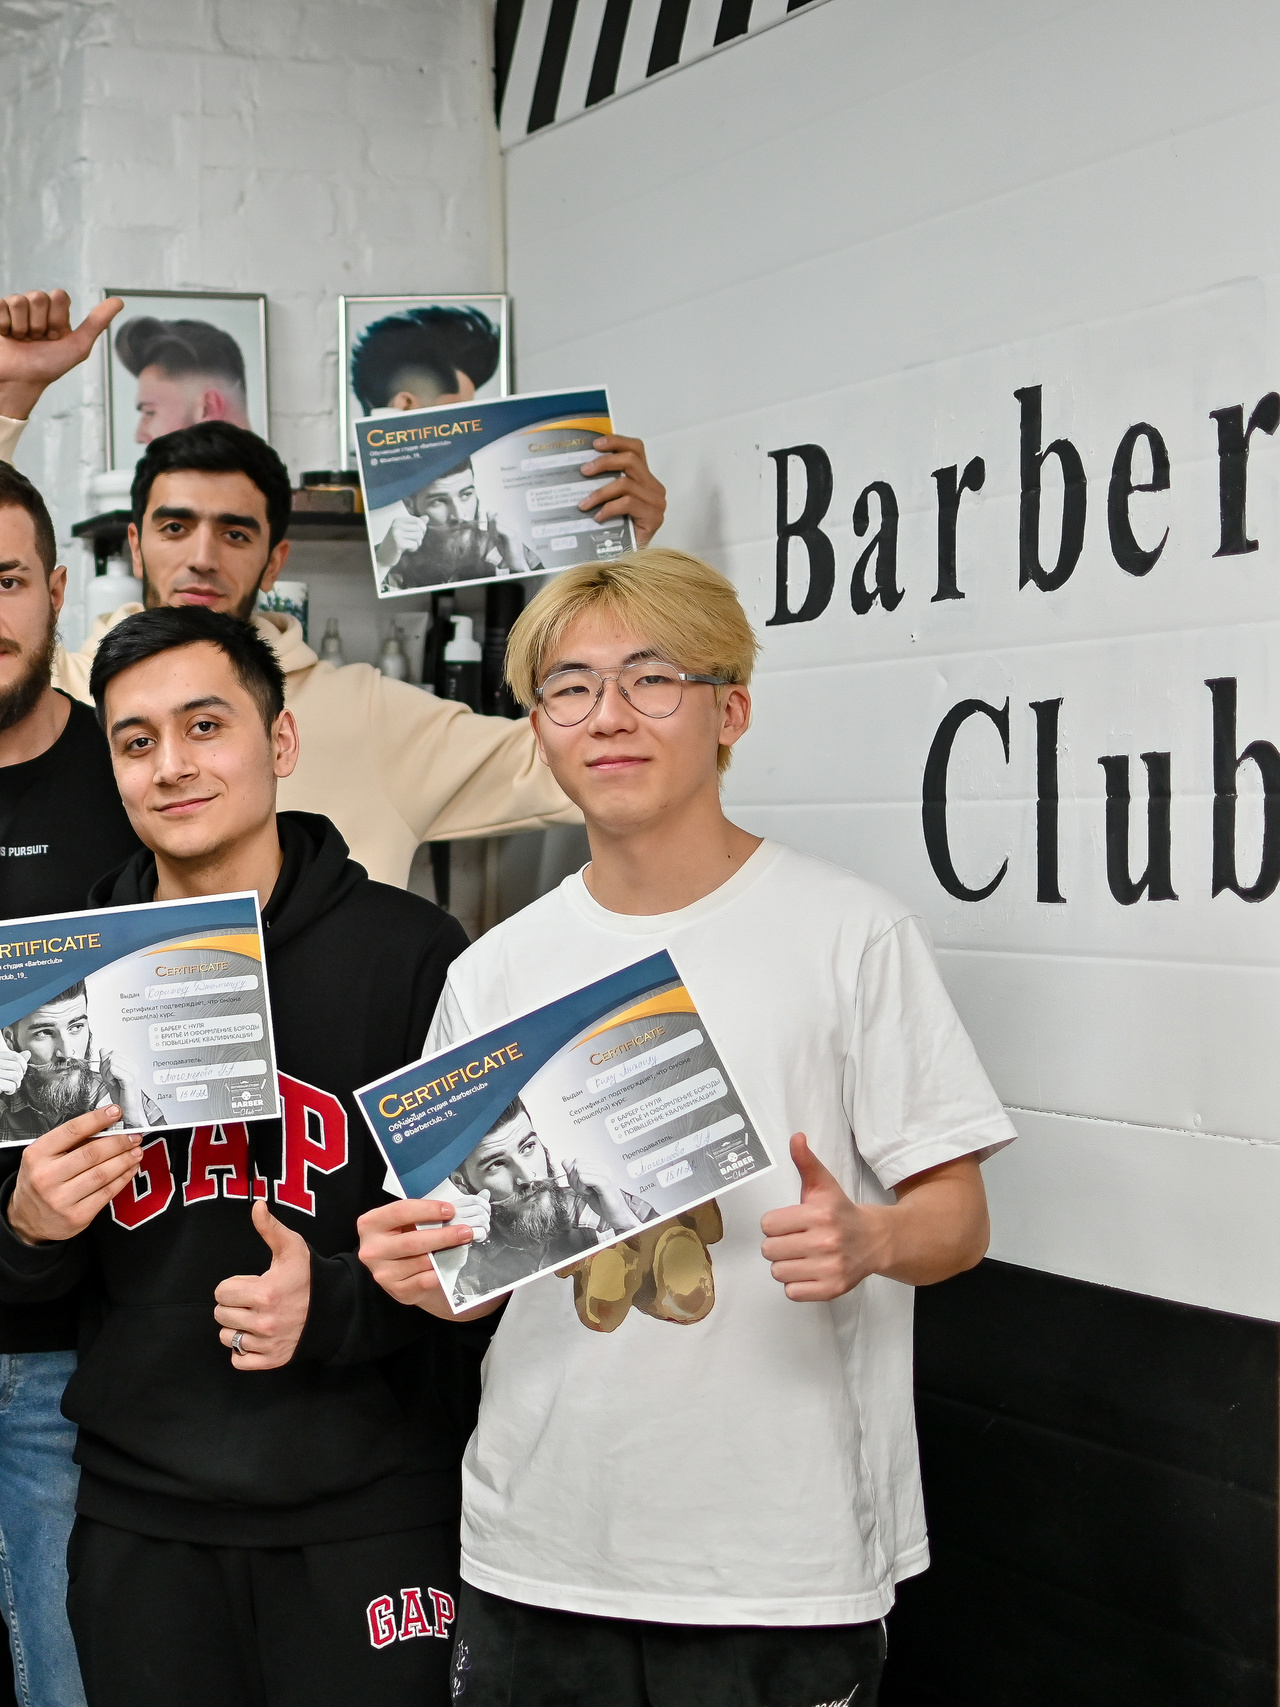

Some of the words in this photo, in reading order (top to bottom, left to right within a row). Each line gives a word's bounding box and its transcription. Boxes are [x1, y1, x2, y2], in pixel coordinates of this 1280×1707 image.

[367, 419, 482, 446] CERTIFICATE
[766, 384, 1280, 626] Barber
[922, 676, 1280, 904] Club
[8, 844, 49, 857] PURSUIT
[2, 962, 23, 970] студия
[24, 957, 62, 966] «Barberclub»
[155, 961, 228, 976] CERTIFICATE
[121, 1004, 158, 1014] Сертификат
[159, 999, 206, 1010] подтверждает,
[121, 1012, 159, 1022] прошел(ла)
[160, 1024, 182, 1032] БАРБЕР
[161, 1037, 200, 1046] ПОВЫШЕНИЕ
[202, 1032, 253, 1042] КВАЛИФИКАЦИИ
[189, 1026, 232, 1036] ОФОРМЛЕНИЕ
[233, 1024, 259, 1032] БОРОДЫ
[589, 1024, 666, 1065] CERTIFICATE
[379, 1041, 524, 1117] CERTIFICATE
[568, 1095, 608, 1117] Сертификат
[606, 1072, 656, 1100] подтверждает,
[654, 1067, 668, 1076] что
[667, 1056, 691, 1071] он/она
[230, 1099, 264, 1108] BARBER
[425, 1100, 448, 1114] студия
[447, 1080, 488, 1103] «Barberclub»
[561, 1088, 583, 1103] Выдан
[648, 1091, 694, 1115] ОФОРМЛЕНИЕ
[693, 1078, 721, 1095] БОРОДЫ
[572, 1102, 611, 1125] прошел(ла)
[616, 1107, 640, 1122] БАРБЕР
[645, 1096, 663, 1108] НУЛЯ
[623, 1113, 664, 1136] ПОВЫШЕНИЕ
[664, 1089, 717, 1117] КВАЛИФИКАЦИИ
[403, 1108, 457, 1137] @barberclub_19_
[719, 1154, 755, 1175] BARBER
[367, 1587, 455, 1649] GAP
